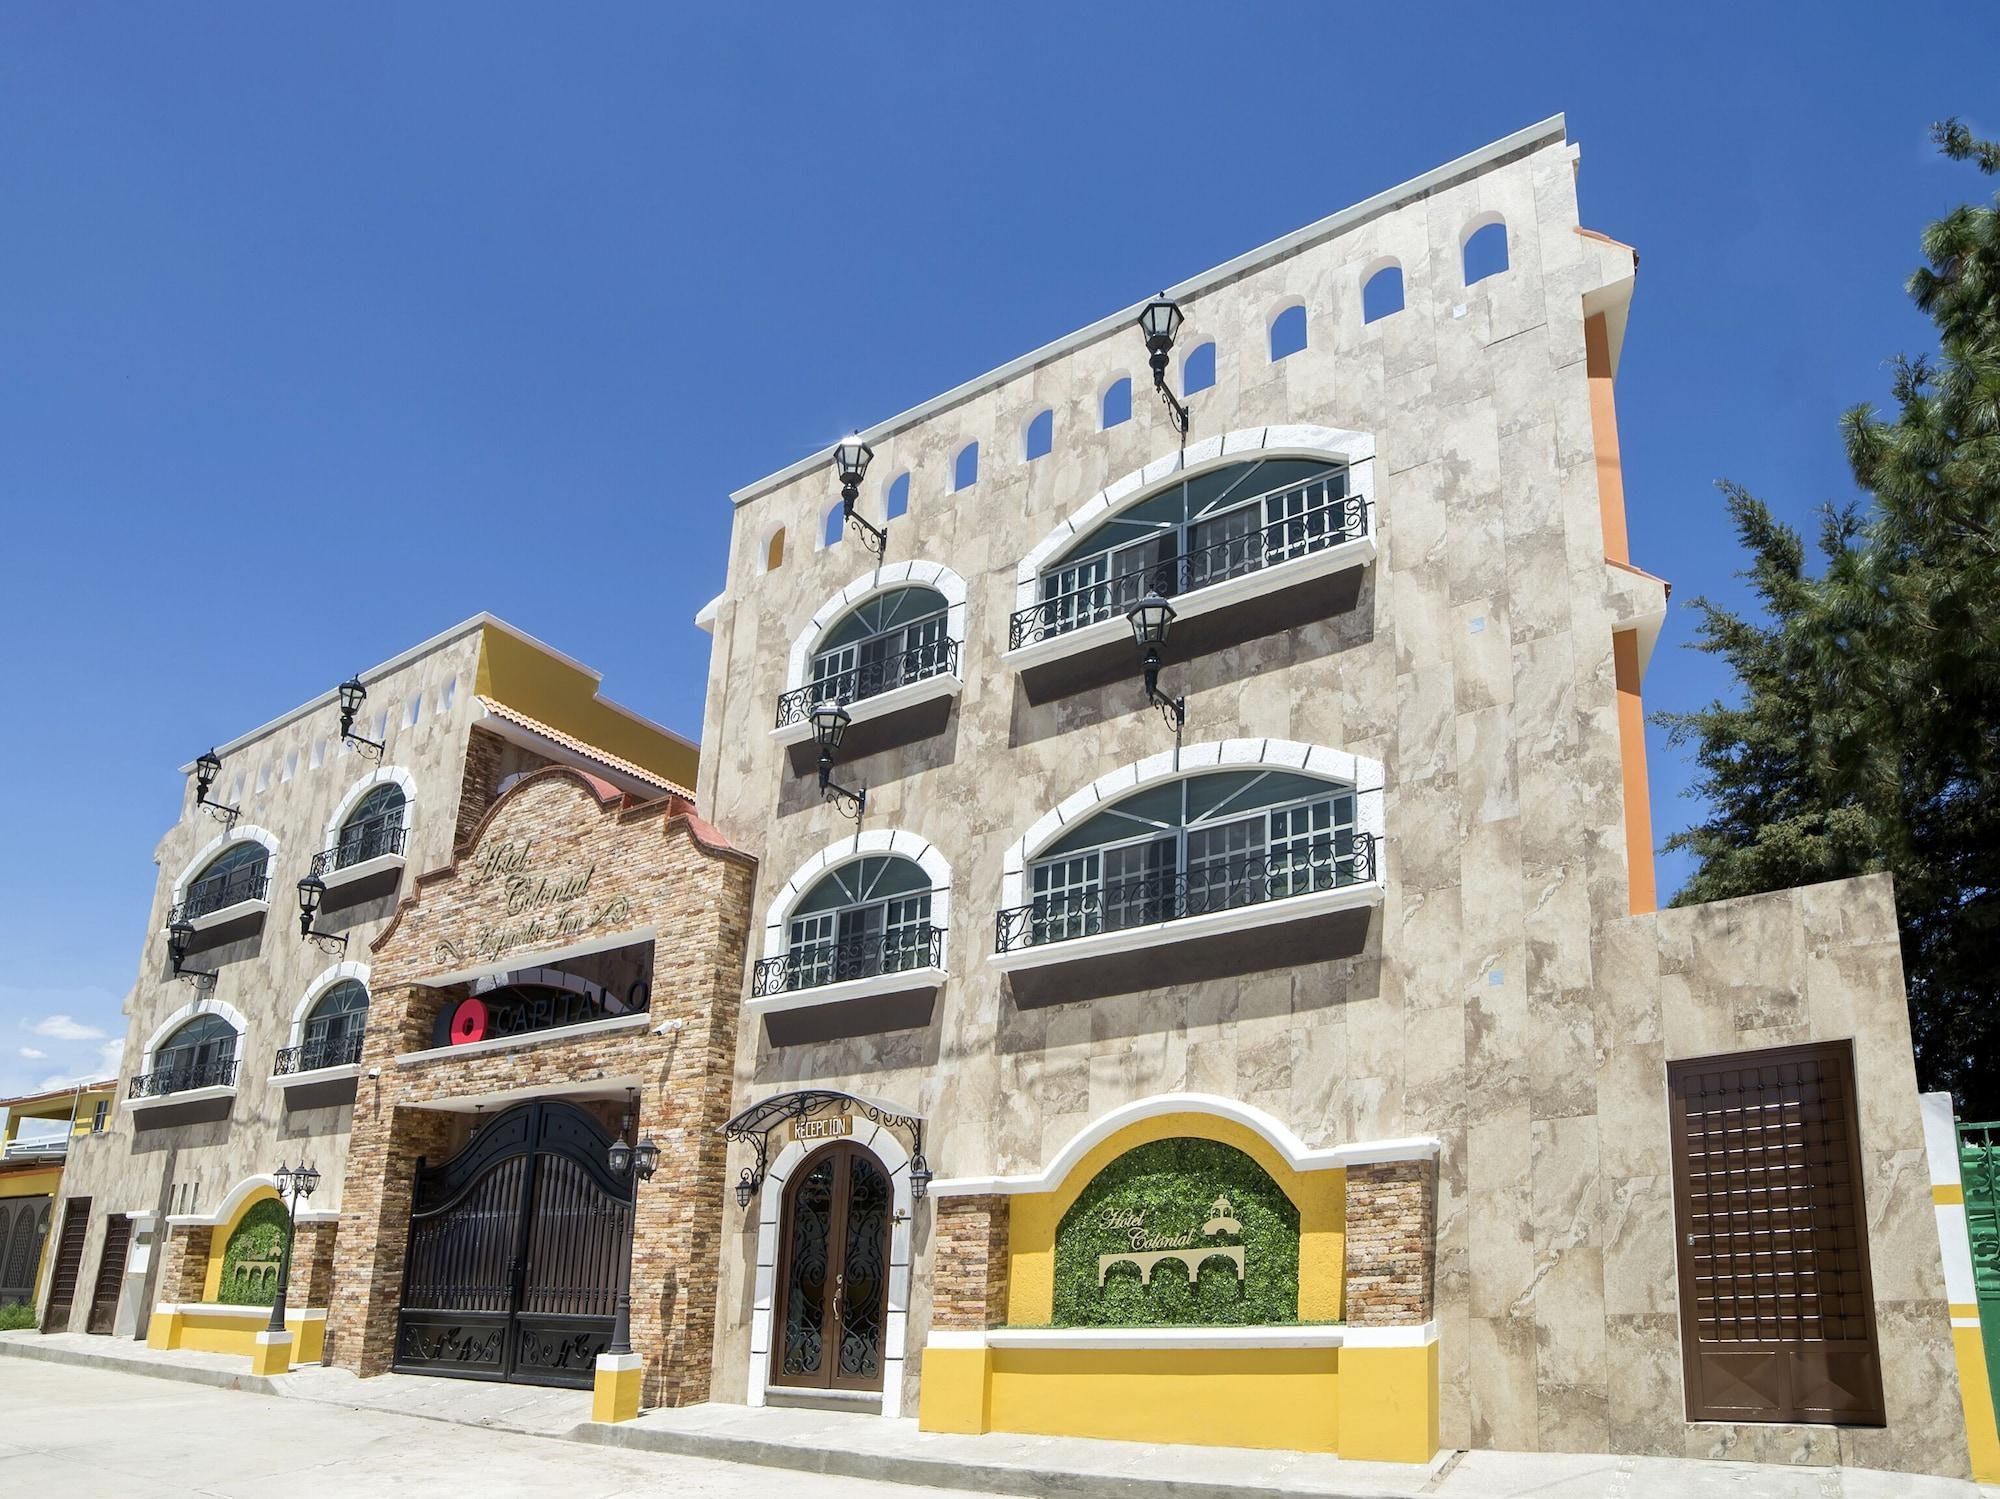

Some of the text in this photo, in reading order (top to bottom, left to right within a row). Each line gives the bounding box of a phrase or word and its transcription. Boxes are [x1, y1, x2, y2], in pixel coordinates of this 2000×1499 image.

[469, 839, 532, 886] Hotel
[504, 863, 596, 916] Colonial
[496, 987, 610, 1034] CAPITAL
[628, 979, 650, 1012] O
[794, 1115, 846, 1139] RECEPCIÓN
[1100, 1207, 1147, 1230] Hotel
[1128, 1227, 1196, 1251] Colonial
